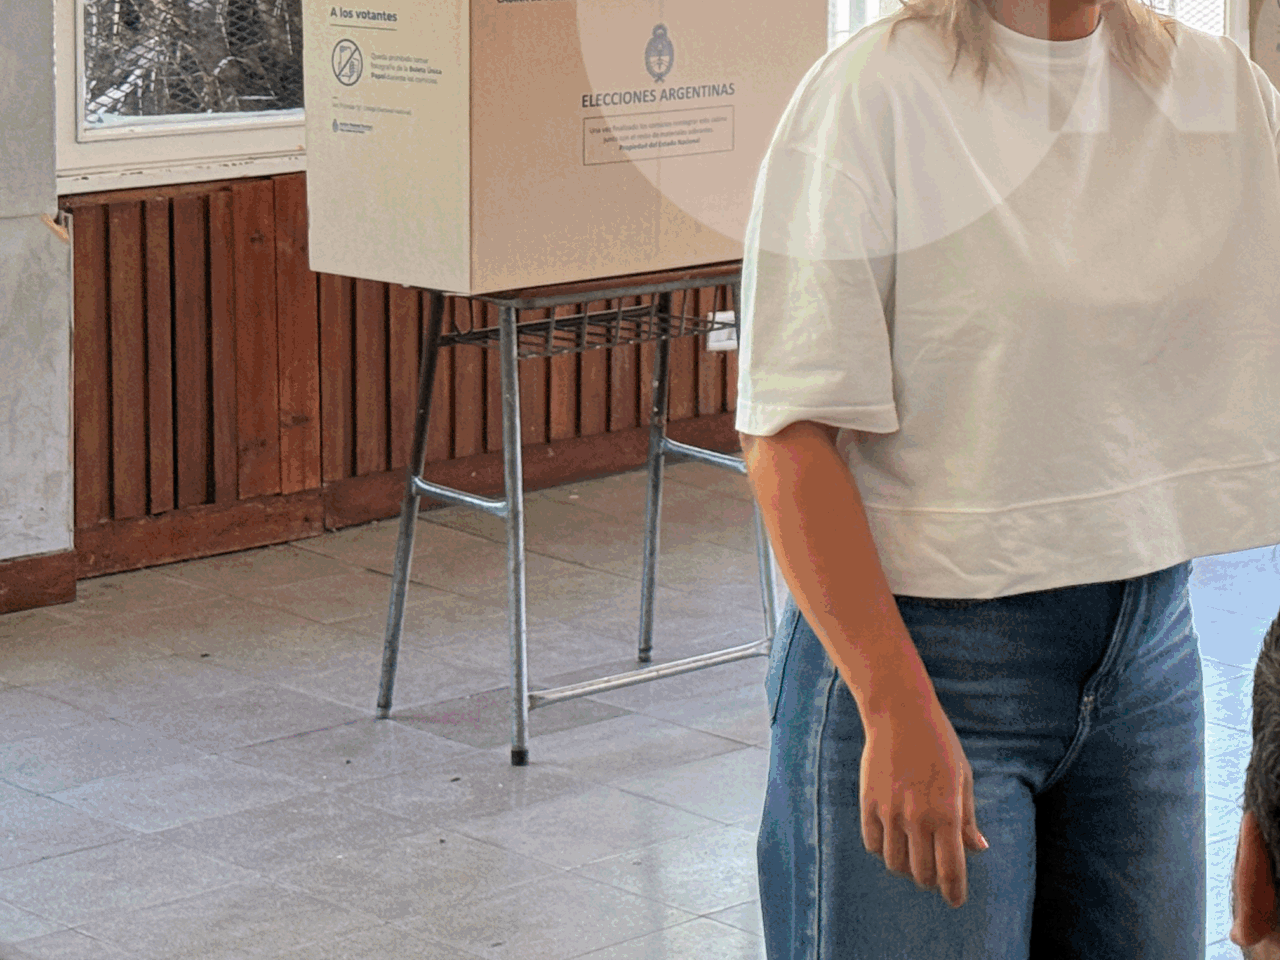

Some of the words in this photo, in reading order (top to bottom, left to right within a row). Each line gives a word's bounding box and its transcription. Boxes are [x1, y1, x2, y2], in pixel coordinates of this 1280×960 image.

[330, 6, 338, 18] A
[340, 6, 354, 19] los
[355, 9, 398, 22] votantes
[582, 90, 656, 108] ELECCIONES
[660, 82, 735, 102] ARGENTINAS
